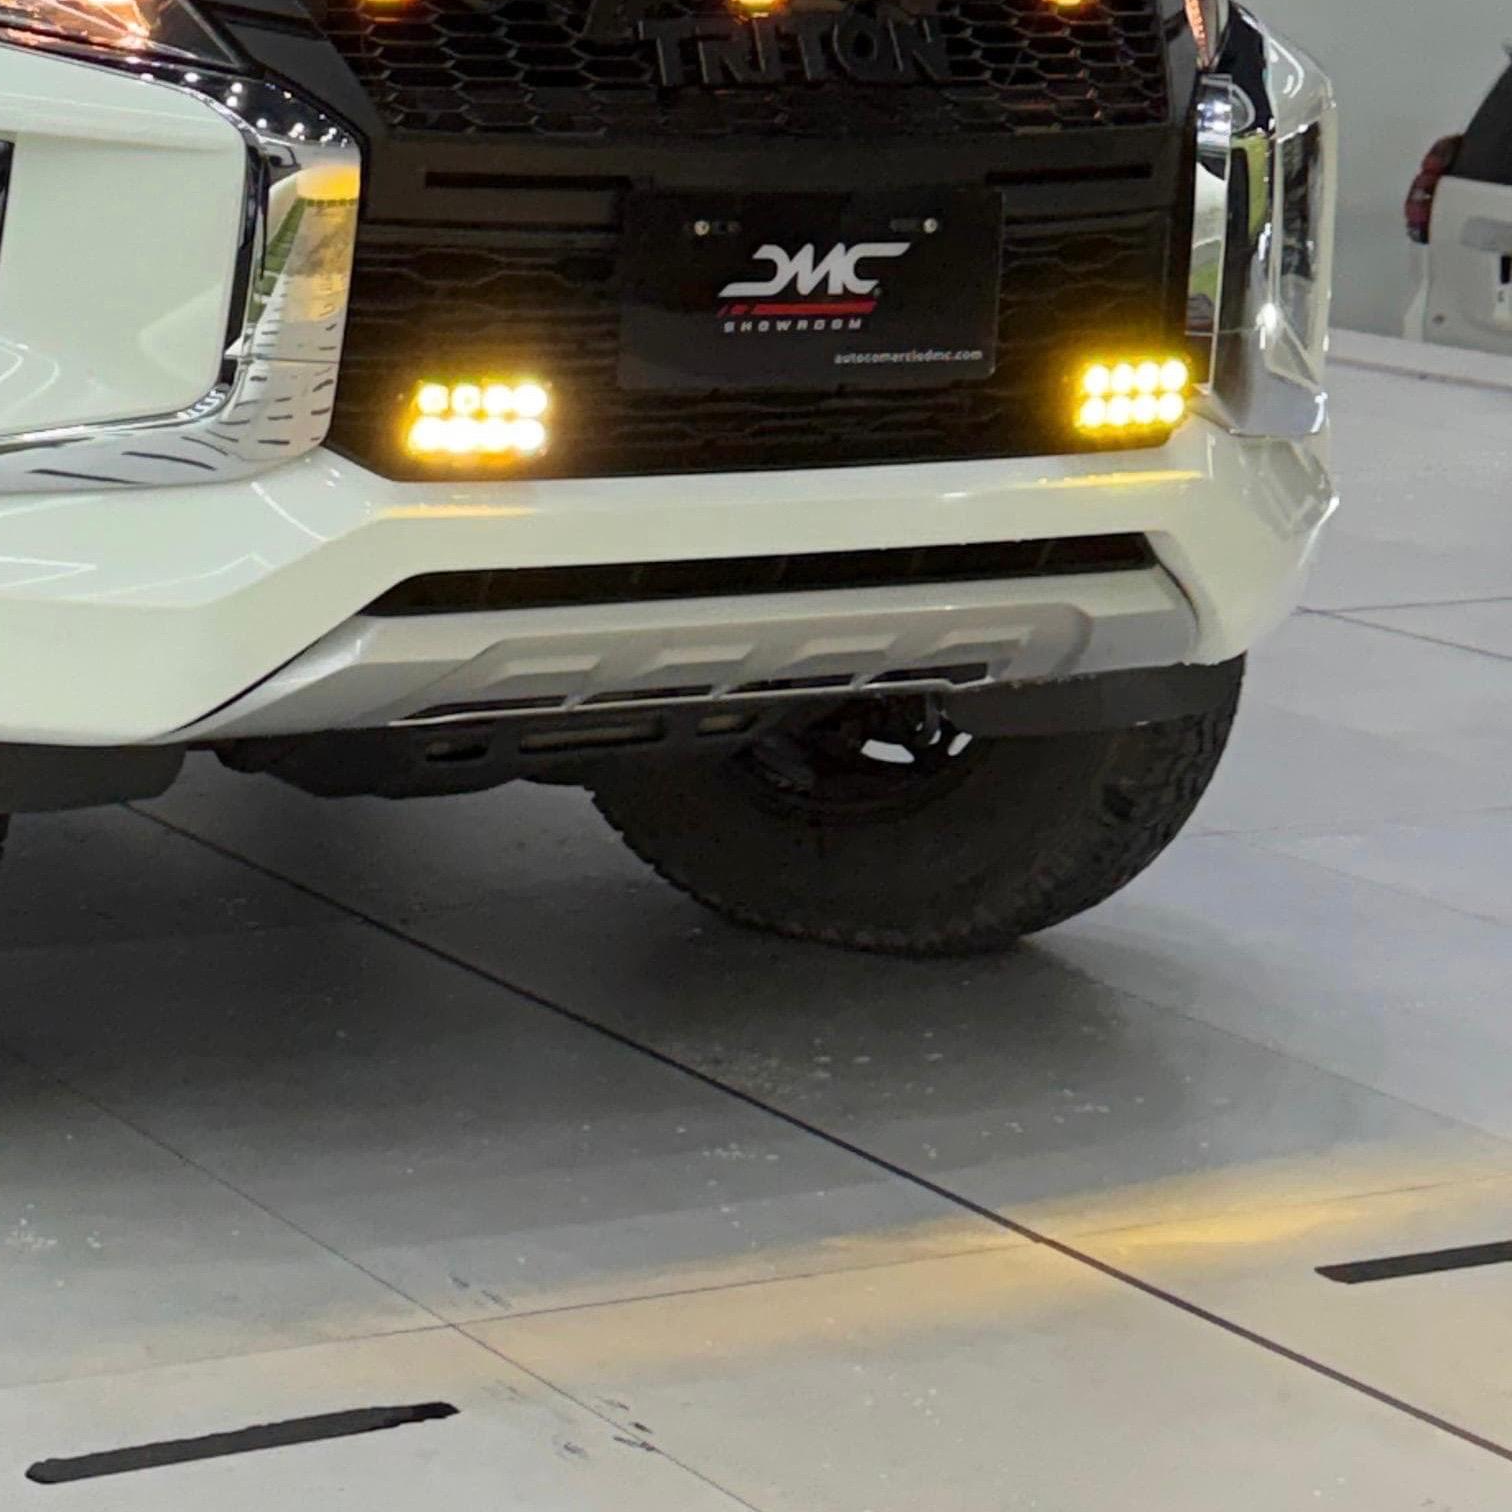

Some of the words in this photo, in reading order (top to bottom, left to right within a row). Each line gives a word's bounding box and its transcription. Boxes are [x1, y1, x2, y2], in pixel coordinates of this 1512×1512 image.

[639, 12, 947, 86] TRITON
[717, 241, 911, 298] DMC
[723, 318, 862, 334] SHOWROOM
[834, 348, 983, 365] autocomerciodmc.com
